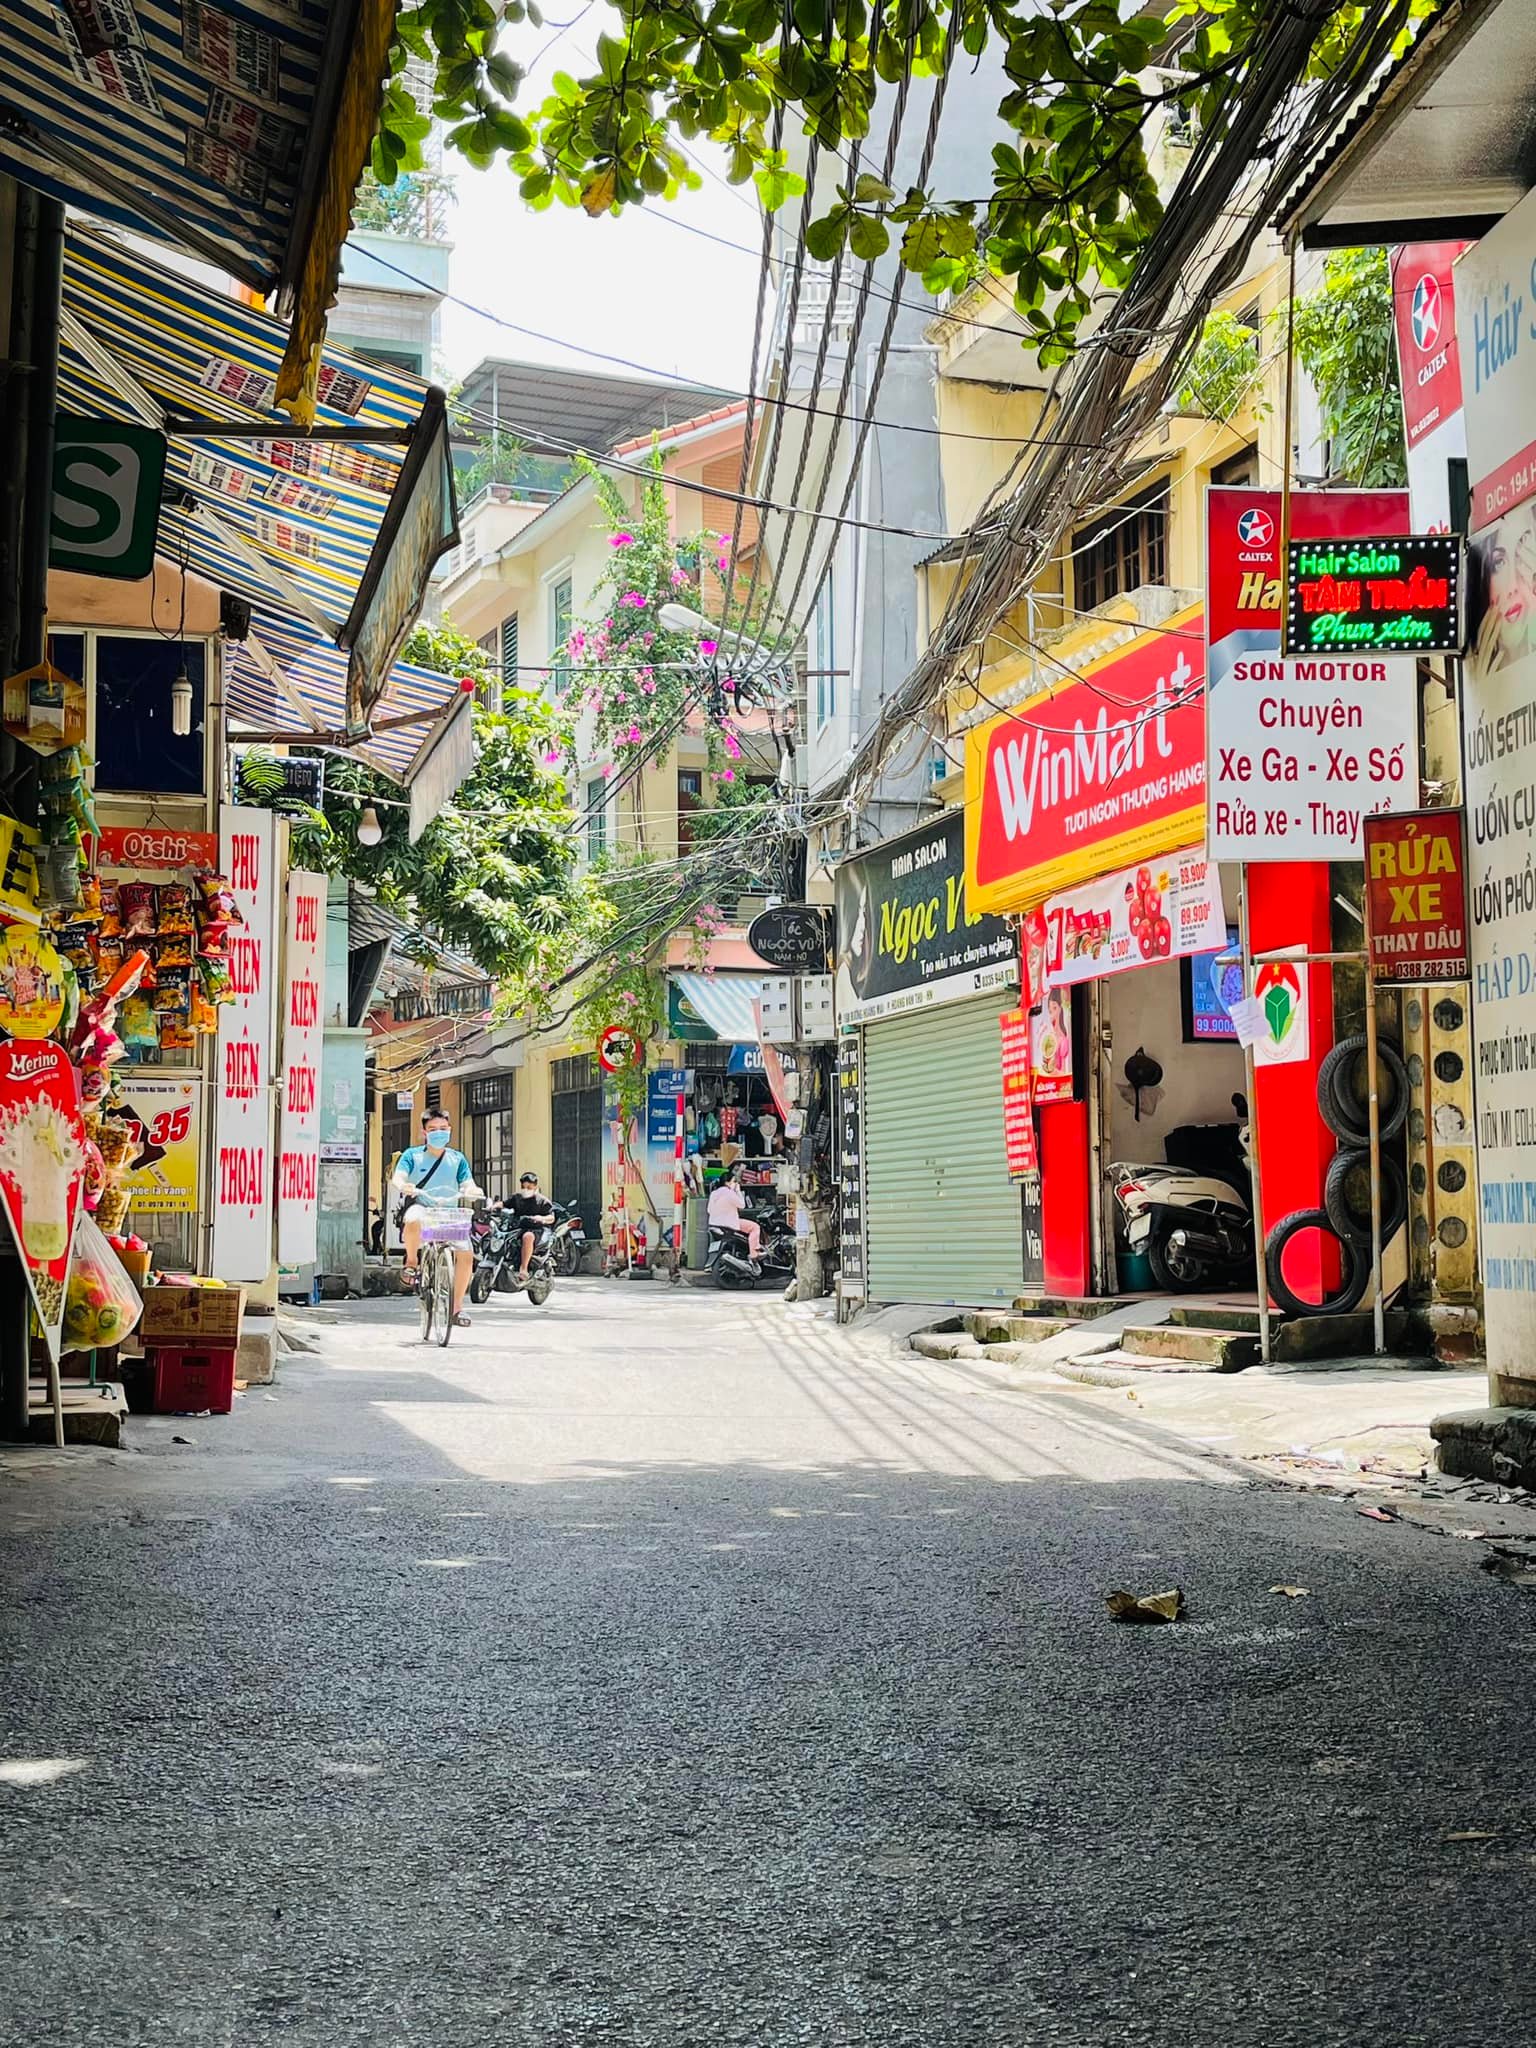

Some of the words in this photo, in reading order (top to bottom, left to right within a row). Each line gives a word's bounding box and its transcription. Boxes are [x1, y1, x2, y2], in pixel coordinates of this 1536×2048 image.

[1475, 282, 1522, 395] Hair
[1418, 349, 1448, 386] CALTEX
[1510, 466, 1528, 496] 194
[1239, 552, 1273, 562] CALTEX
[1300, 553, 1345, 576] Hair
[1348, 549, 1400, 574] Salon
[1298, 574, 1361, 613] TÂM
[1311, 611, 1374, 643] Phun
[1373, 615, 1433, 644] xăm
[1234, 660, 1284, 681] SƠN
[1295, 662, 1387, 681] MOTOR
[1259, 697, 1363, 735] Chuyên
[1468, 709, 1494, 770] UỐN
[1219, 748, 1252, 782] Xe
[1262, 747, 1299, 782] Ga
[1326, 748, 1359, 782] Xe
[1368, 743, 1405, 782] Số
[1089, 797, 1120, 826] NGON
[1121, 777, 1168, 813] THƯỢNG
[1216, 797, 1257, 836] Rửa
[1264, 809, 1288, 836] xe
[1308, 802, 1360, 844] Thay
[1475, 782, 1509, 845] UỐN
[123, 832, 187, 861] Oishi
[892, 852, 914, 879] HAIR
[915, 837, 947, 870] SALON
[1369, 823, 1457, 879] RỬA
[231, 834, 262, 905] PHỤ
[1388, 883, 1443, 923] XE
[1474, 866, 1502, 926] UỐN
[295, 896, 319, 954] PHỤ
[757, 938, 796, 953] NGỌC
[798, 937, 815, 951] VŨ
[771, 914, 802, 938] Tóc
[879, 897, 940, 964] Ngọc
[1373, 932, 1418, 954] THAY
[1424, 924, 1462, 950] DẦU
[227, 922, 262, 1008] KIỆN
[774, 953, 791, 961] NAM
[1396, 962, 1421, 978] 0388
[1424, 961, 1443, 977] 282
[1446, 960, 1465, 976] 515
[1476, 942, 1513, 1004] HẤP
[290, 967, 319, 1039] KIỆN
[10, 1050, 58, 1075] Merino
[225, 1024, 260, 1113] ĐIỆN
[287, 1052, 316, 1125] ĐIỆN
[148, 1102, 194, 1146] 35
[220, 1147, 263, 1219] THOẠI
[281, 1153, 317, 1212] THOẠI
